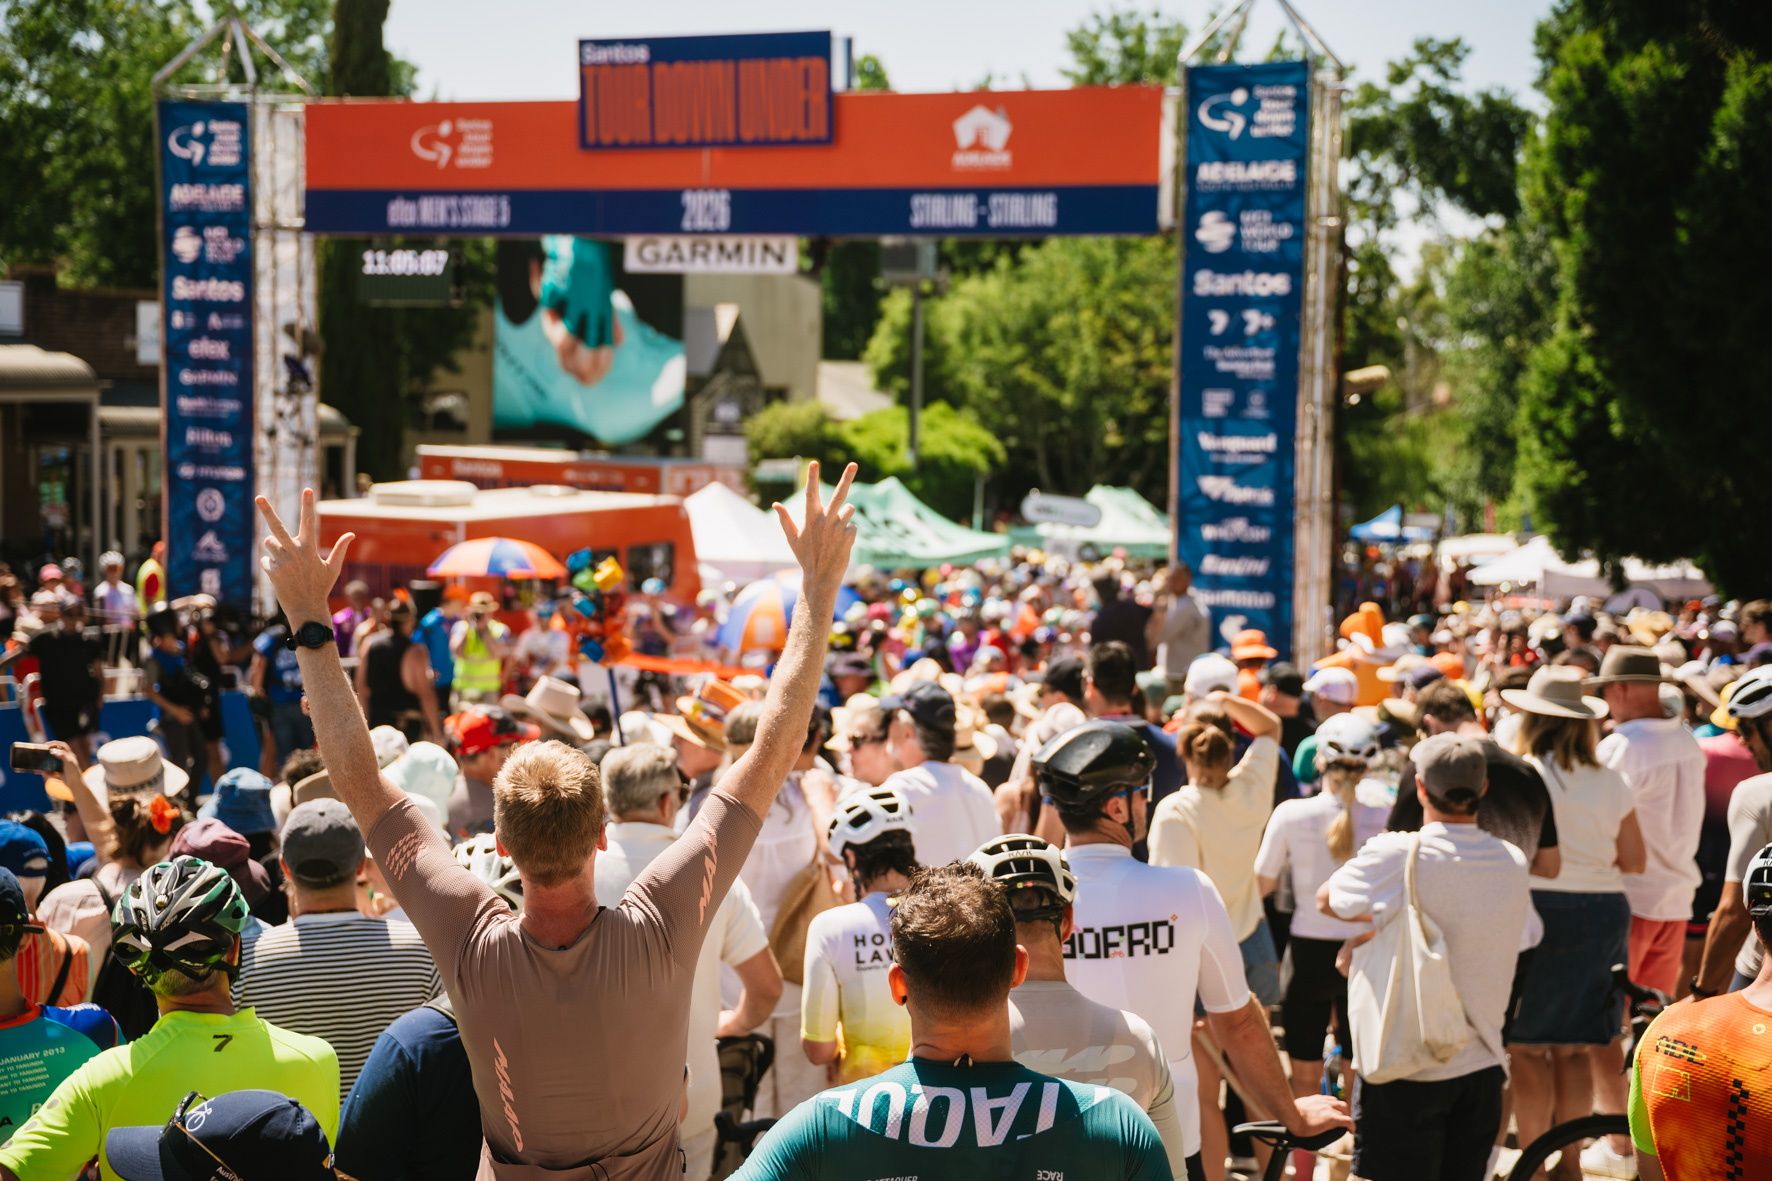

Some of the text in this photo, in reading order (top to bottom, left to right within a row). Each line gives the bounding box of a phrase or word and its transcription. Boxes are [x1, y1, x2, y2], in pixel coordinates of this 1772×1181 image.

[582, 43, 650, 65] Santos
[1196, 160, 1296, 182] ADELAIDE
[636, 237, 786, 266] GARMIN
[172, 275, 244, 302] Santos
[1193, 268, 1292, 297] Santos
[0, 1046, 66, 1065] JANUARY 2013
